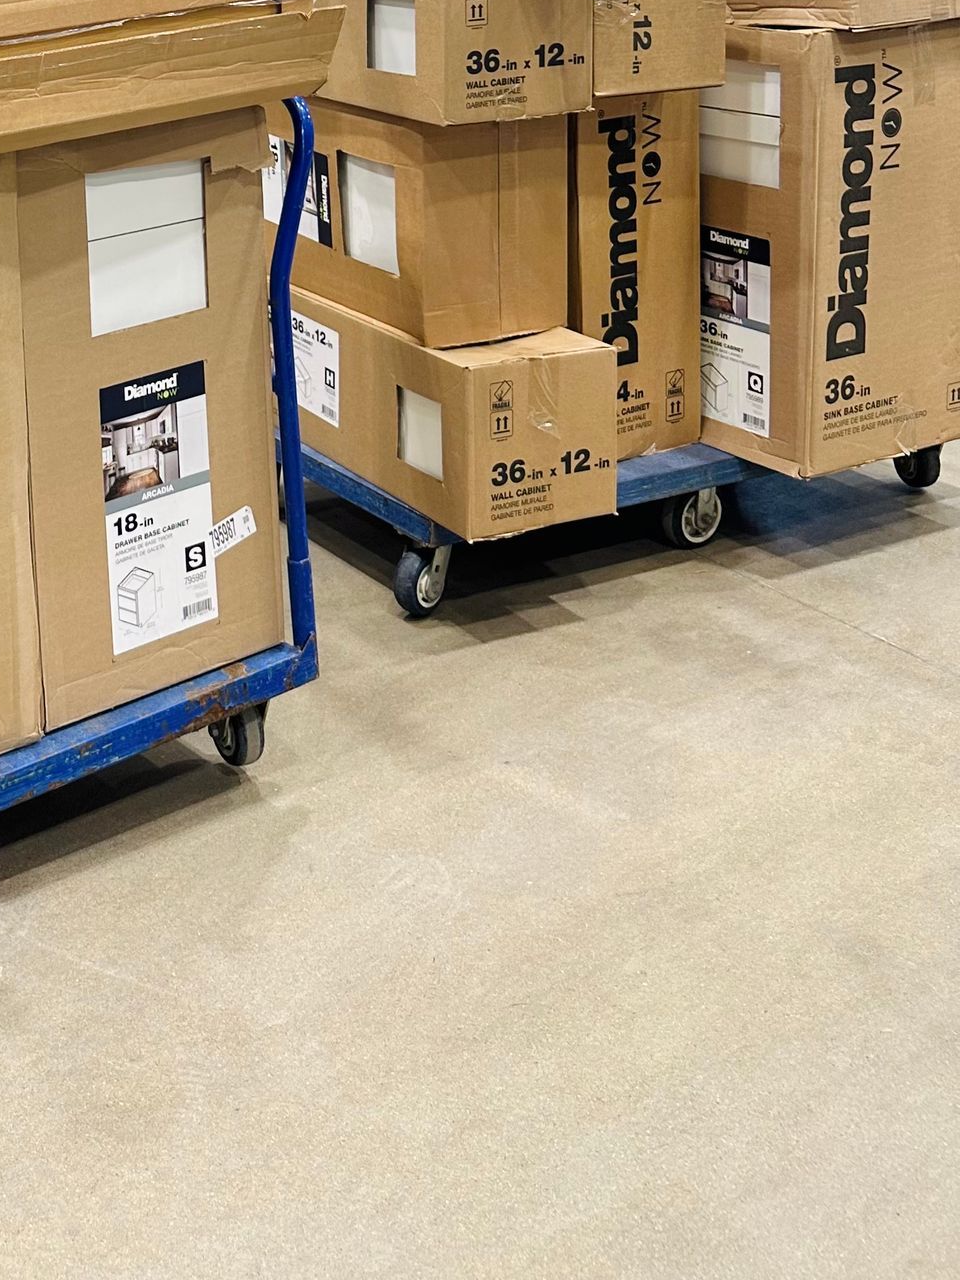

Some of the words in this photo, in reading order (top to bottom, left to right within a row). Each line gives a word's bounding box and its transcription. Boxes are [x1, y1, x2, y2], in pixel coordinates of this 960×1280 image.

[466, 48, 517, 75] 36-in
[523, 60, 531, 69] x
[466, 78, 488, 90] WALL
[490, 75, 526, 88] CABINET
[466, 89, 494, 100] ARMOIRE
[880, 62, 903, 170] NOW
[642, 114, 662, 205] NOW
[825, 62, 875, 362] Diamond
[598, 114, 639, 366] Diamond
[710, 230, 749, 249] Diamond
[700, 320, 728, 340] 36-in
[124, 372, 178, 401] Diamond
[157, 388, 178, 401] NOW
[748, 373, 763, 394] Q
[825, 375, 871, 404] 36-in
[621, 402, 650, 416] CABINET
[824, 408, 842, 421] SINK
[844, 404, 863, 416] BASE
[865, 395, 898, 410] CABINET
[823, 419, 848, 431] ARMOIRE
[860, 413, 874, 422] BASE
[822, 428, 851, 441] GABINETE
[491, 459, 543, 487] 36-in
[549, 468, 557, 477] x
[142, 484, 175, 501] ARCADIA
[491, 490, 514, 502] WALL
[516, 483, 552, 498] CABINET
[491, 500, 519, 512] ARMOIRE
[521, 495, 547, 506] MURALE
[491, 510, 522, 521] GABINETE
[533, 503, 554, 513] PARED
[113, 513, 154, 536] 18-in
[115, 534, 143, 549] DRAWER
[144, 530, 161, 540] BASE
[162, 519, 190, 533] CABINET
[209, 518, 237, 550] 795987
[187, 545, 204, 569] S
